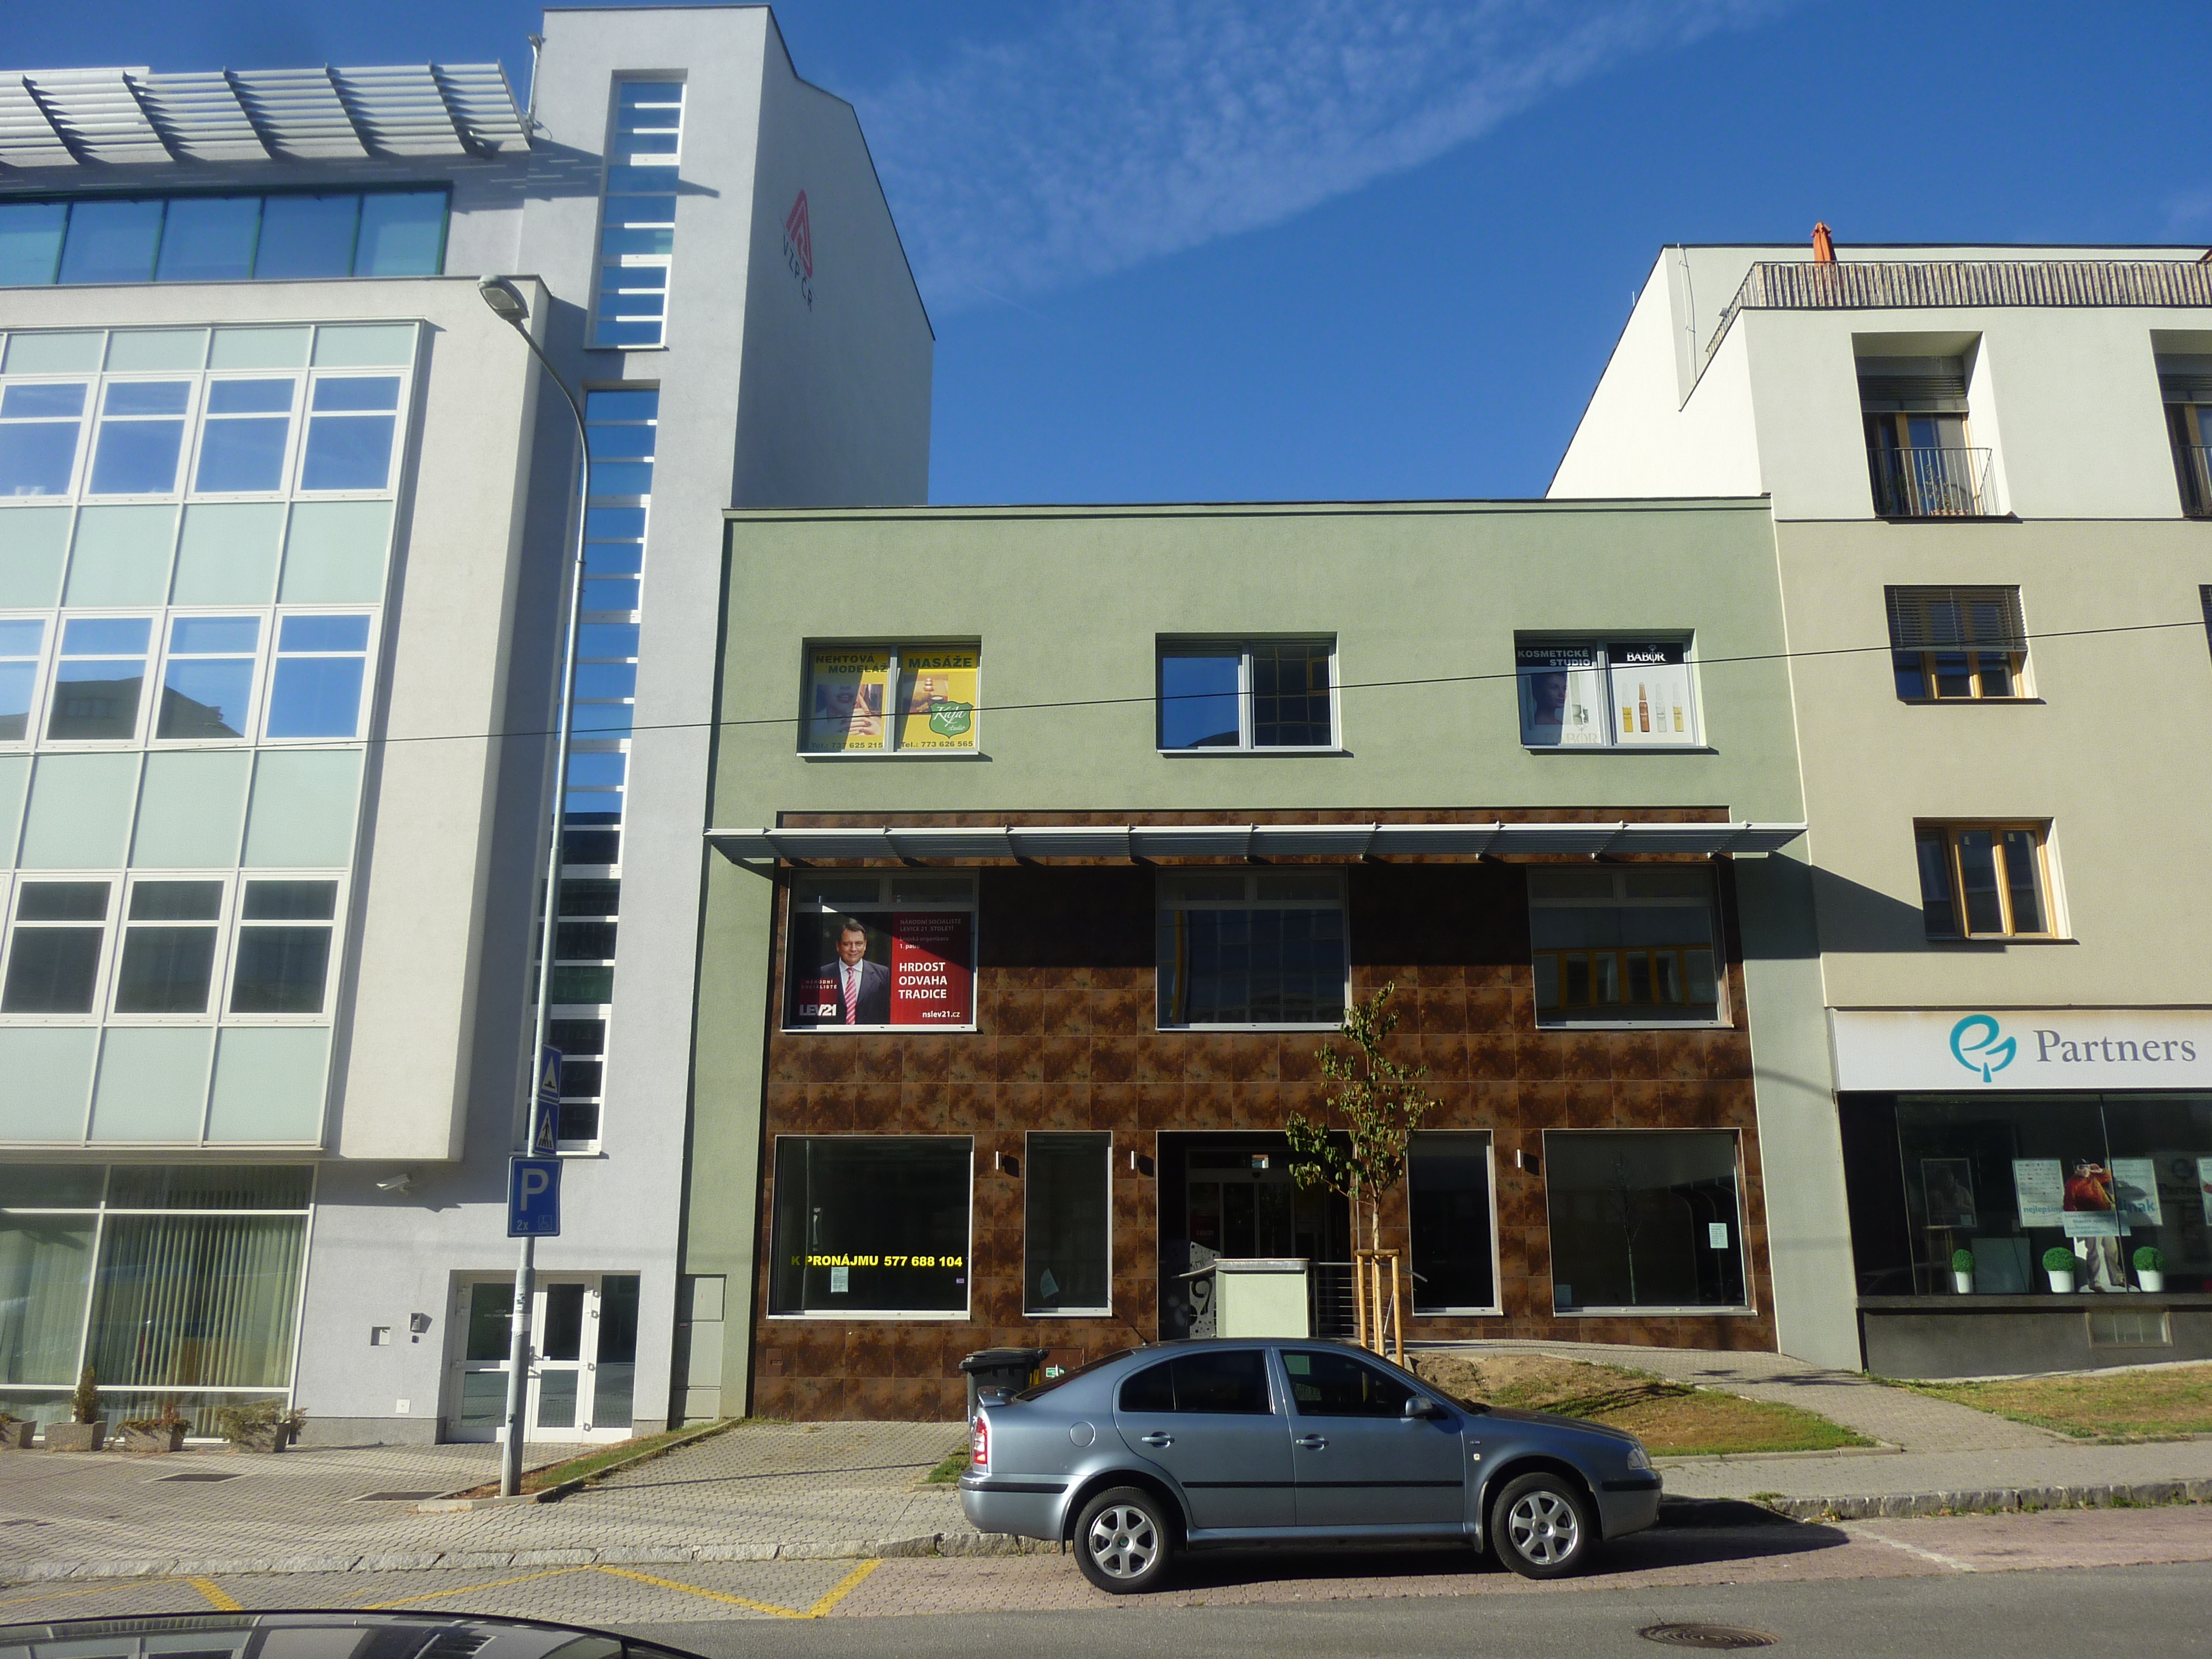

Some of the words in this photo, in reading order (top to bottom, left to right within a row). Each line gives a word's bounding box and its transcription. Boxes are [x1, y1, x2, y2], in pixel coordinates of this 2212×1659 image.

[816, 653, 875, 664] NEHTOVÁ
[1517, 648, 1589, 658] KOSMETICKÉ
[1626, 651, 1667, 662] BABOR
[909, 655, 972, 668] MASÁŽE
[899, 962, 946, 972] HRDOST
[899, 975, 948, 985] ODVAHA
[898, 989, 947, 999] TRADICE
[799, 1004, 837, 1016] LEV21
[2033, 1030, 2197, 1062] Partners
[520, 1168, 549, 1211] P
[517, 1219, 528, 1231] 2x
[791, 1256, 800, 1265] K
[805, 1253, 879, 1266] PRONÁJMU
[884, 1256, 908, 1266] 577
[911, 1256, 935, 1266] 688
[939, 1256, 963, 1267] 104
